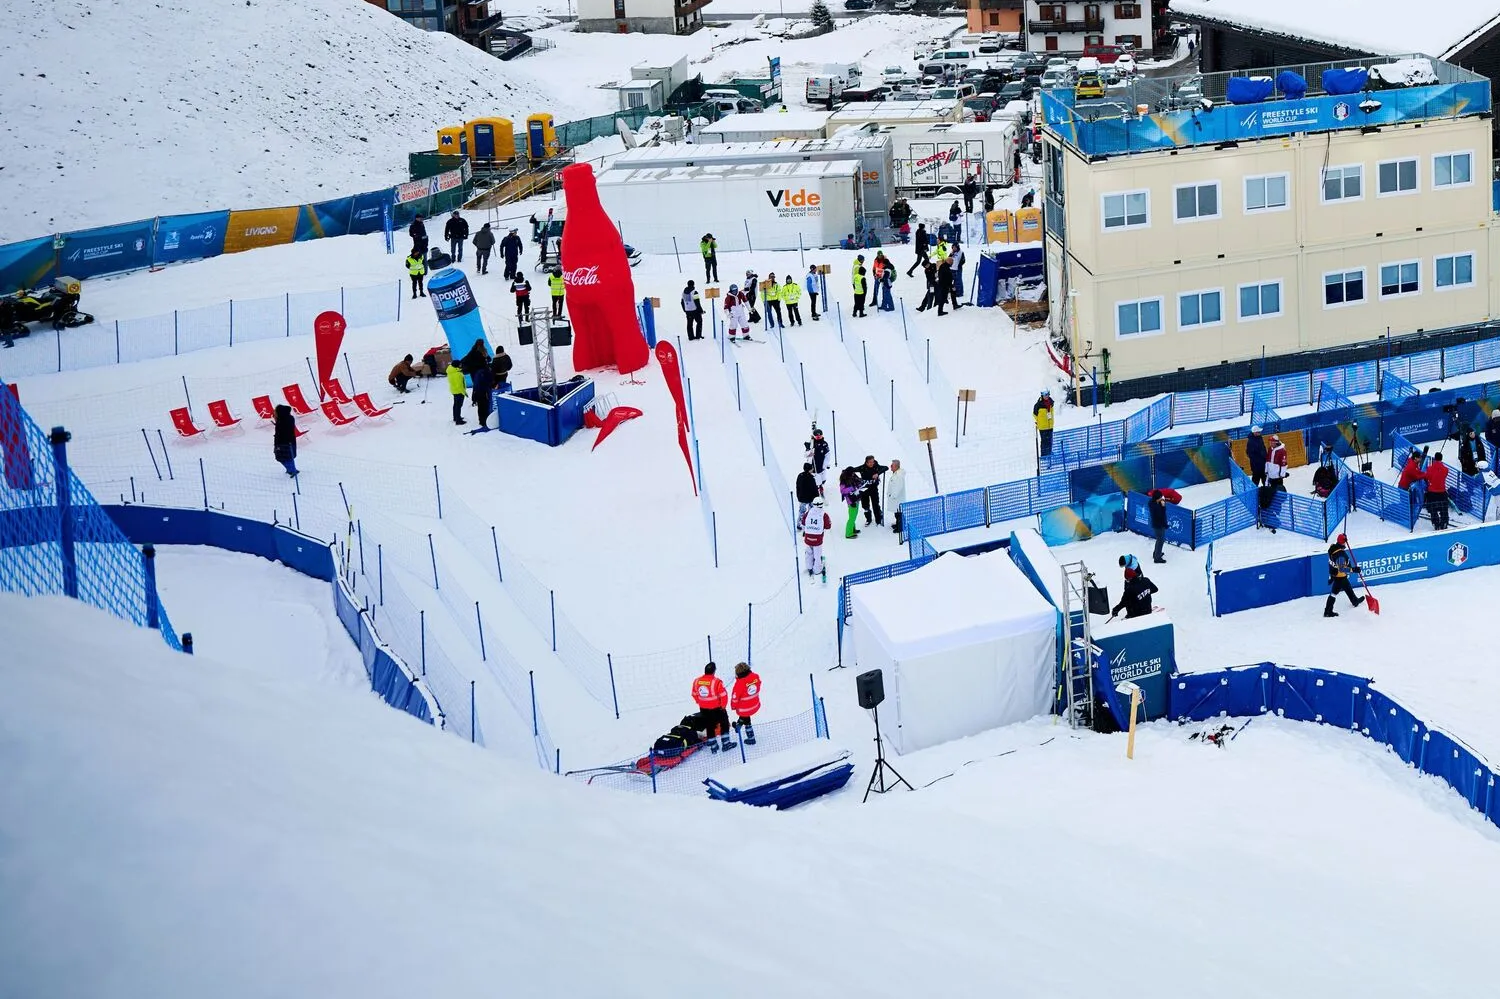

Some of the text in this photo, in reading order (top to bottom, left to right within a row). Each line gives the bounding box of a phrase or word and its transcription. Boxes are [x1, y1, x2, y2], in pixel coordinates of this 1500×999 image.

[1262, 107, 1318, 119] FREESTYLE SKI
[1263, 116, 1284, 124] WORLD
[913, 161, 943, 177] rental
[245, 226, 278, 236] LIVIGNO
[438, 285, 467, 302] POWER
[1357, 551, 1428, 569] FREESTYLE SKI
[1387, 564, 1401, 572] CUP
[1110, 657, 1161, 675] FREESTYLE SKI
[1111, 664, 1162, 682] WORLD CUP
